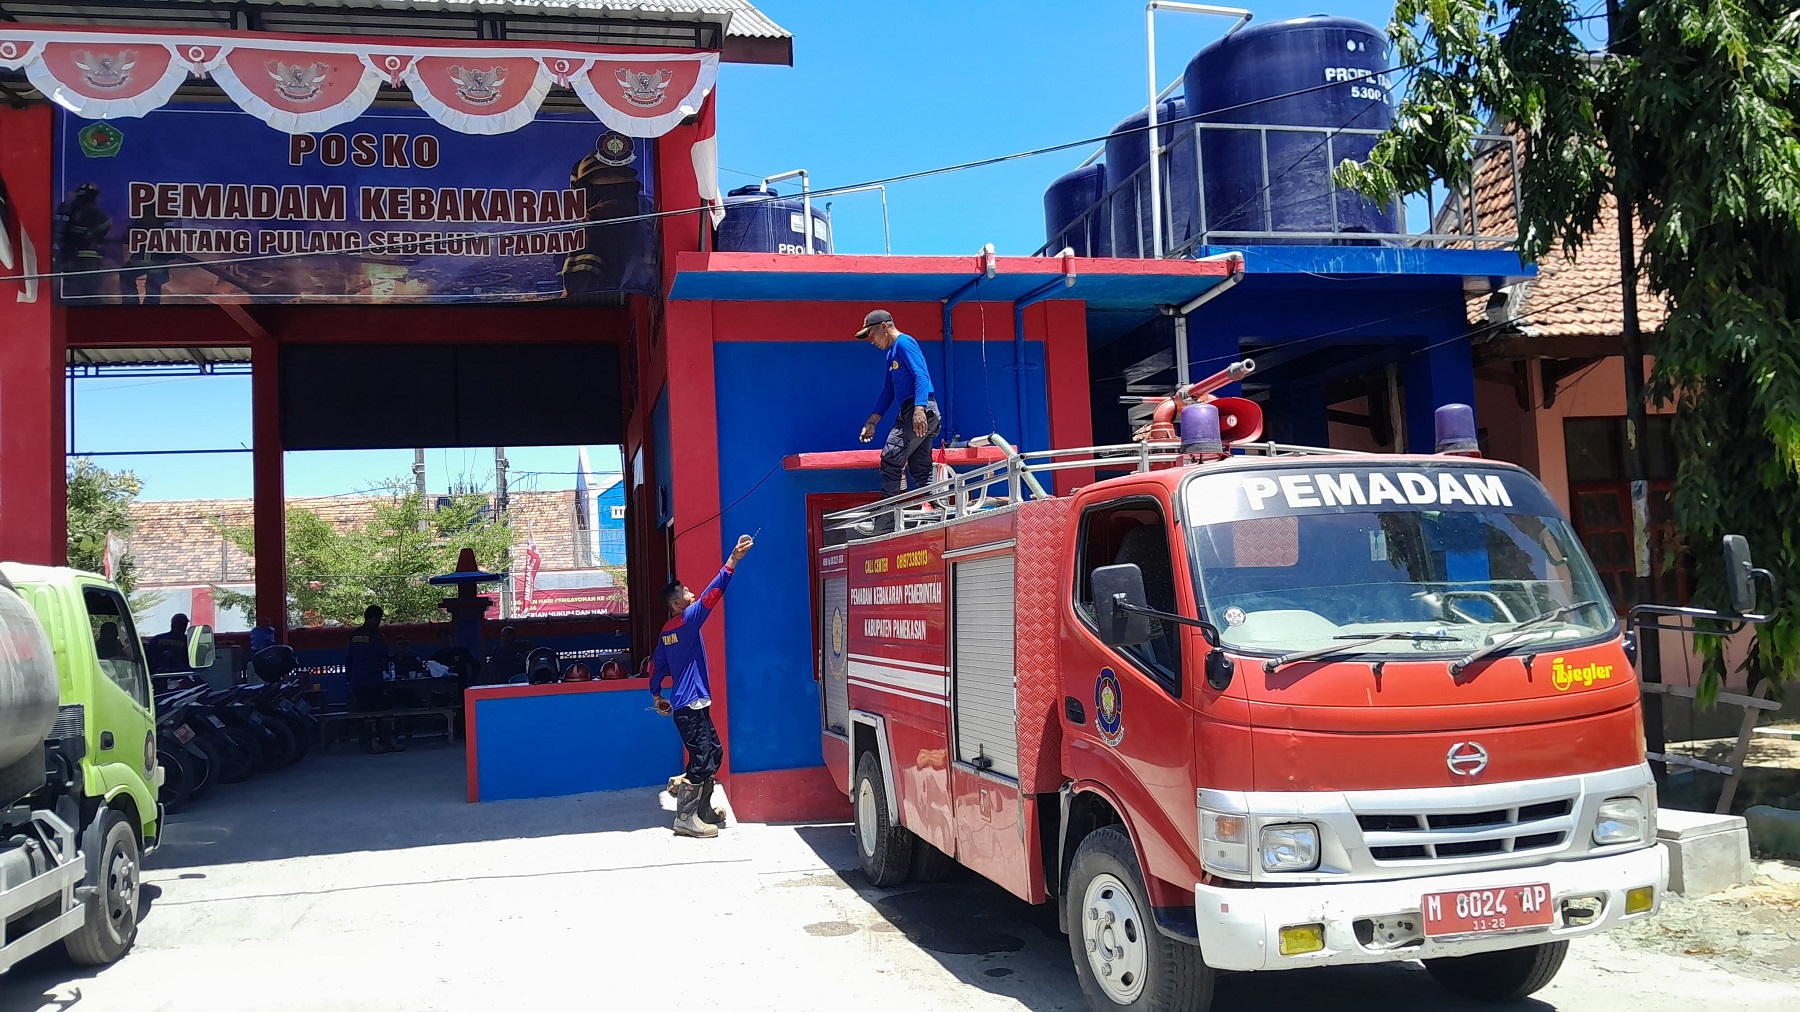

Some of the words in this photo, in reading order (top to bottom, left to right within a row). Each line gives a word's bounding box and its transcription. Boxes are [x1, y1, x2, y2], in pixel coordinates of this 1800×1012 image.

[1325, 67, 1376, 84] PROFIL
[1351, 86, 1381, 101] 5300
[1382, 93, 1389, 104] L
[289, 132, 440, 169] POSKO
[128, 181, 347, 221] PEMADAM
[359, 185, 587, 223] KEBAKARAN
[129, 229, 251, 254] PANTANG
[259, 231, 362, 255] PULANG
[368, 230, 492, 257] SEBELUM
[497, 229, 586, 256] PADAM
[1241, 472, 1513, 511] PEMADAM
[865, 559, 874, 574] CALL
[874, 557, 889, 573] CENTER
[850, 587, 873, 606] PEMADAM
[873, 584, 903, 605] KEBAKARAN
[904, 581, 942, 604] PEMERINTAH
[864, 618, 892, 638] KABUPATEN
[892, 619, 926, 640] PAMEKASAN
[1427, 895, 1442, 922] M
[1456, 889, 1508, 919] 8024
[1521, 885, 1546, 913] AP
